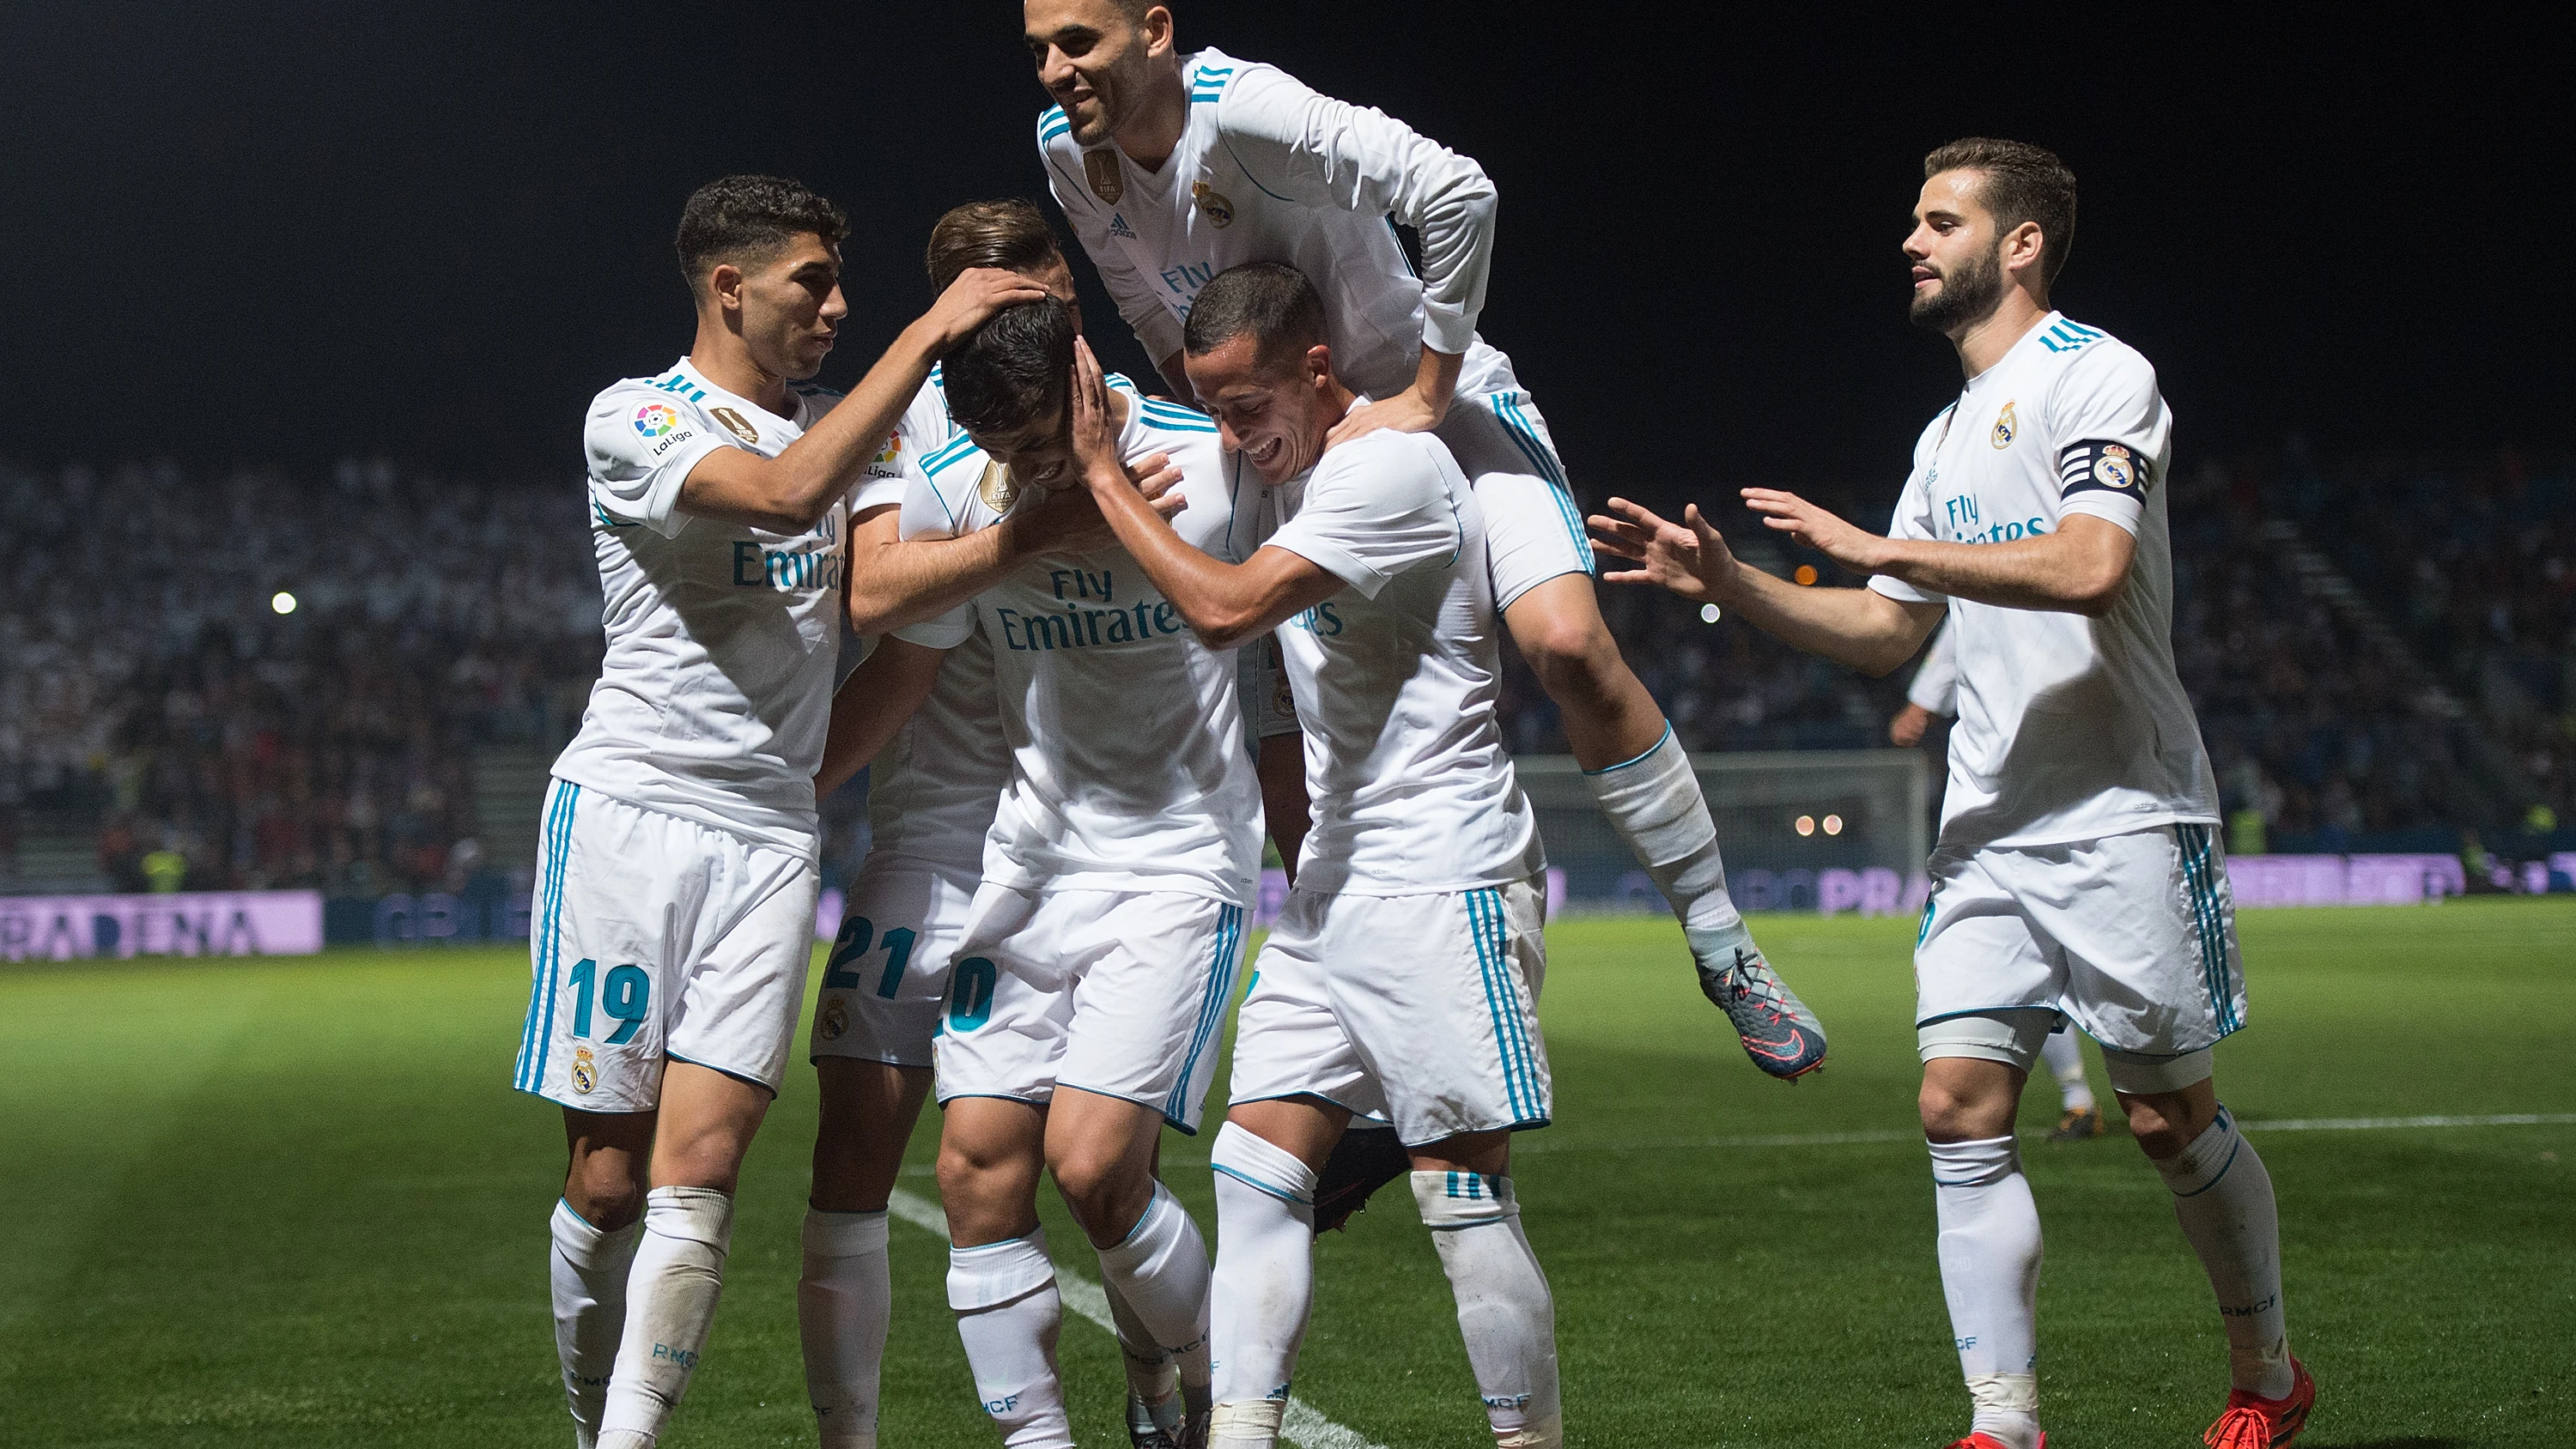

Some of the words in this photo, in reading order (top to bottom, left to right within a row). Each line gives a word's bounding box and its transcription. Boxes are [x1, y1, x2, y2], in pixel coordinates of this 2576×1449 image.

[653, 430, 693, 457] LaLiga
[864, 465, 896, 479] Liga
[992, 492, 1011, 500] FIFA
[1946, 493, 1979, 530] Fly
[1050, 568, 1114, 603] Fly
[996, 599, 1189, 652] Emirate
[825, 915, 917, 1001] 21
[568, 957, 651, 1046] 19
[933, 956, 997, 1034] 0
